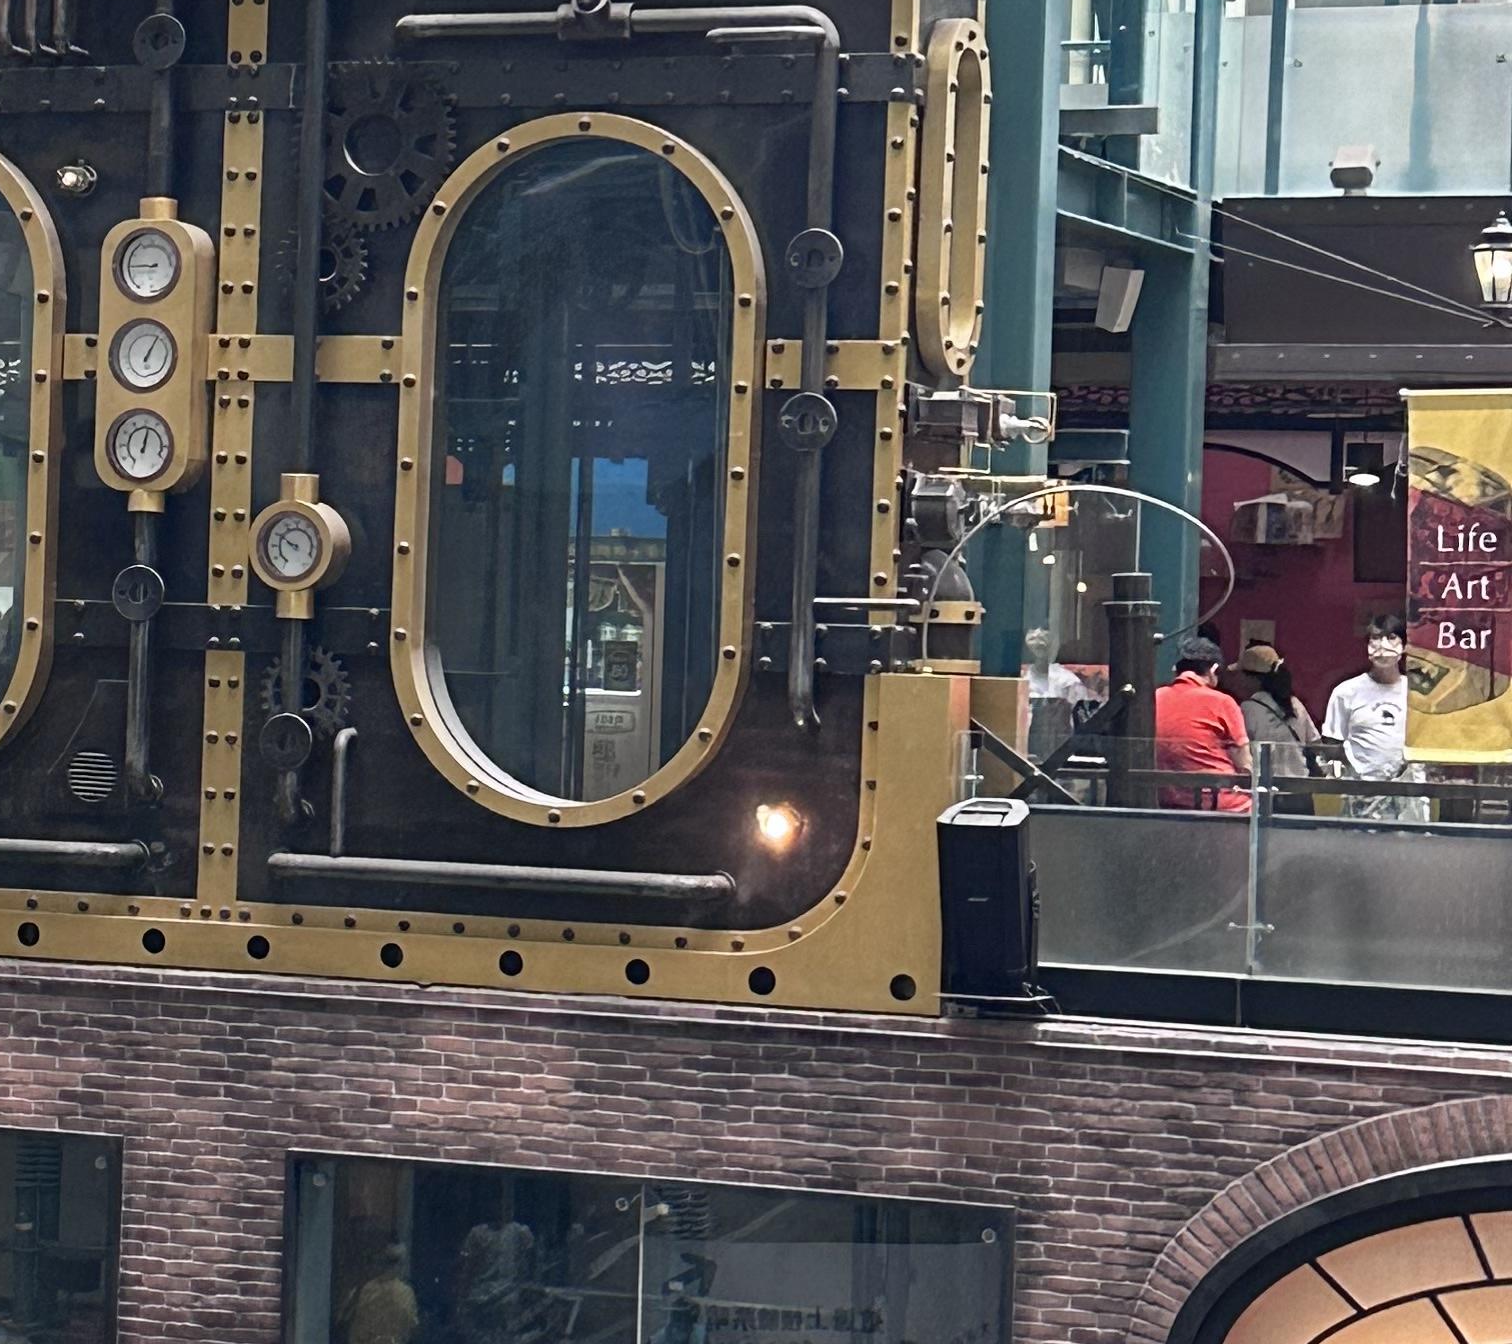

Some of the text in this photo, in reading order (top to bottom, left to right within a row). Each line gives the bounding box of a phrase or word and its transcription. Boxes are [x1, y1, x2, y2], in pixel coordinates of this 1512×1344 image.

[1437, 521, 1498, 553] Life
[1441, 572, 1490, 600] Art
[1437, 621, 1492, 650] Bar
